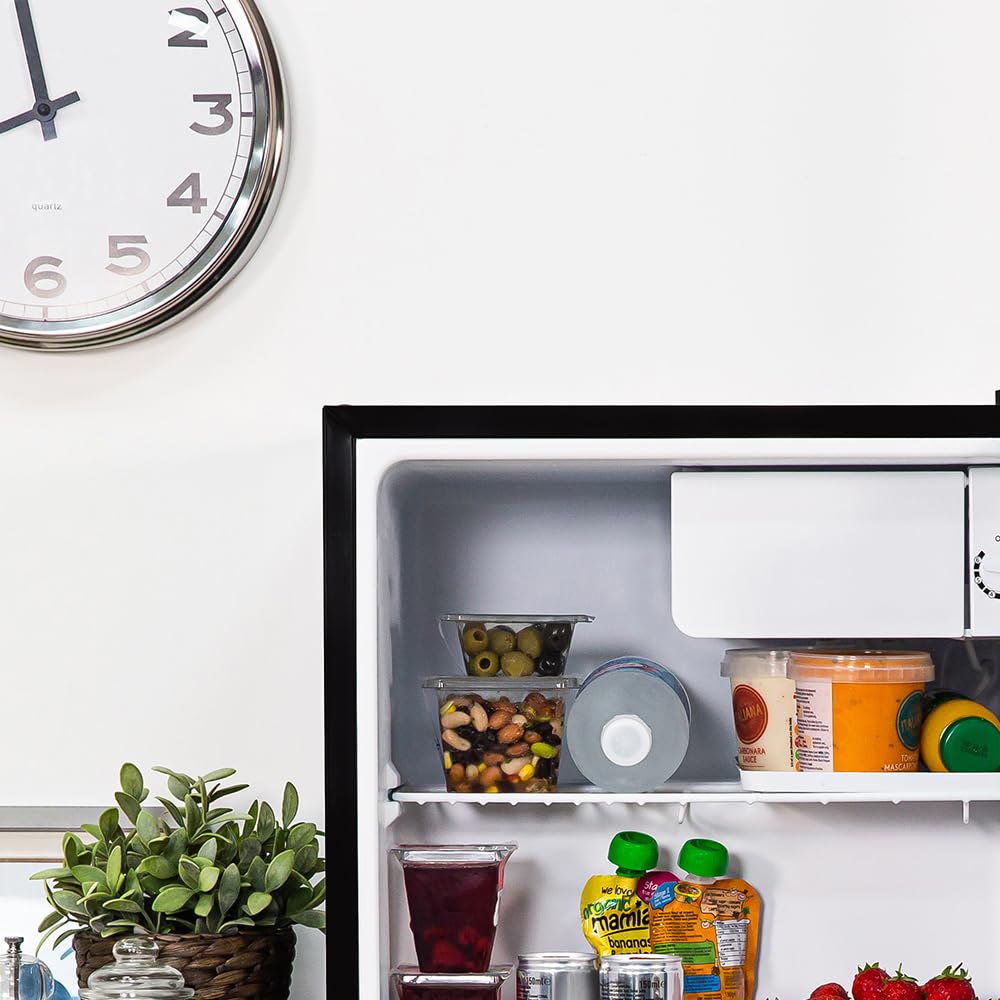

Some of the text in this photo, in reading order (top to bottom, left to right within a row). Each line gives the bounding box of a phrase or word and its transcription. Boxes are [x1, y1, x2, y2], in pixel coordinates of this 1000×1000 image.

[168, 7, 209, 48] 2
[189, 93, 234, 136] 3
[31, 202, 62, 211] quartz
[166, 172, 208, 214] 4
[105, 235, 151, 276] 5
[24, 256, 67, 299] 6
[584, 899, 631, 920] organic
[592, 908, 650, 931] mamia
